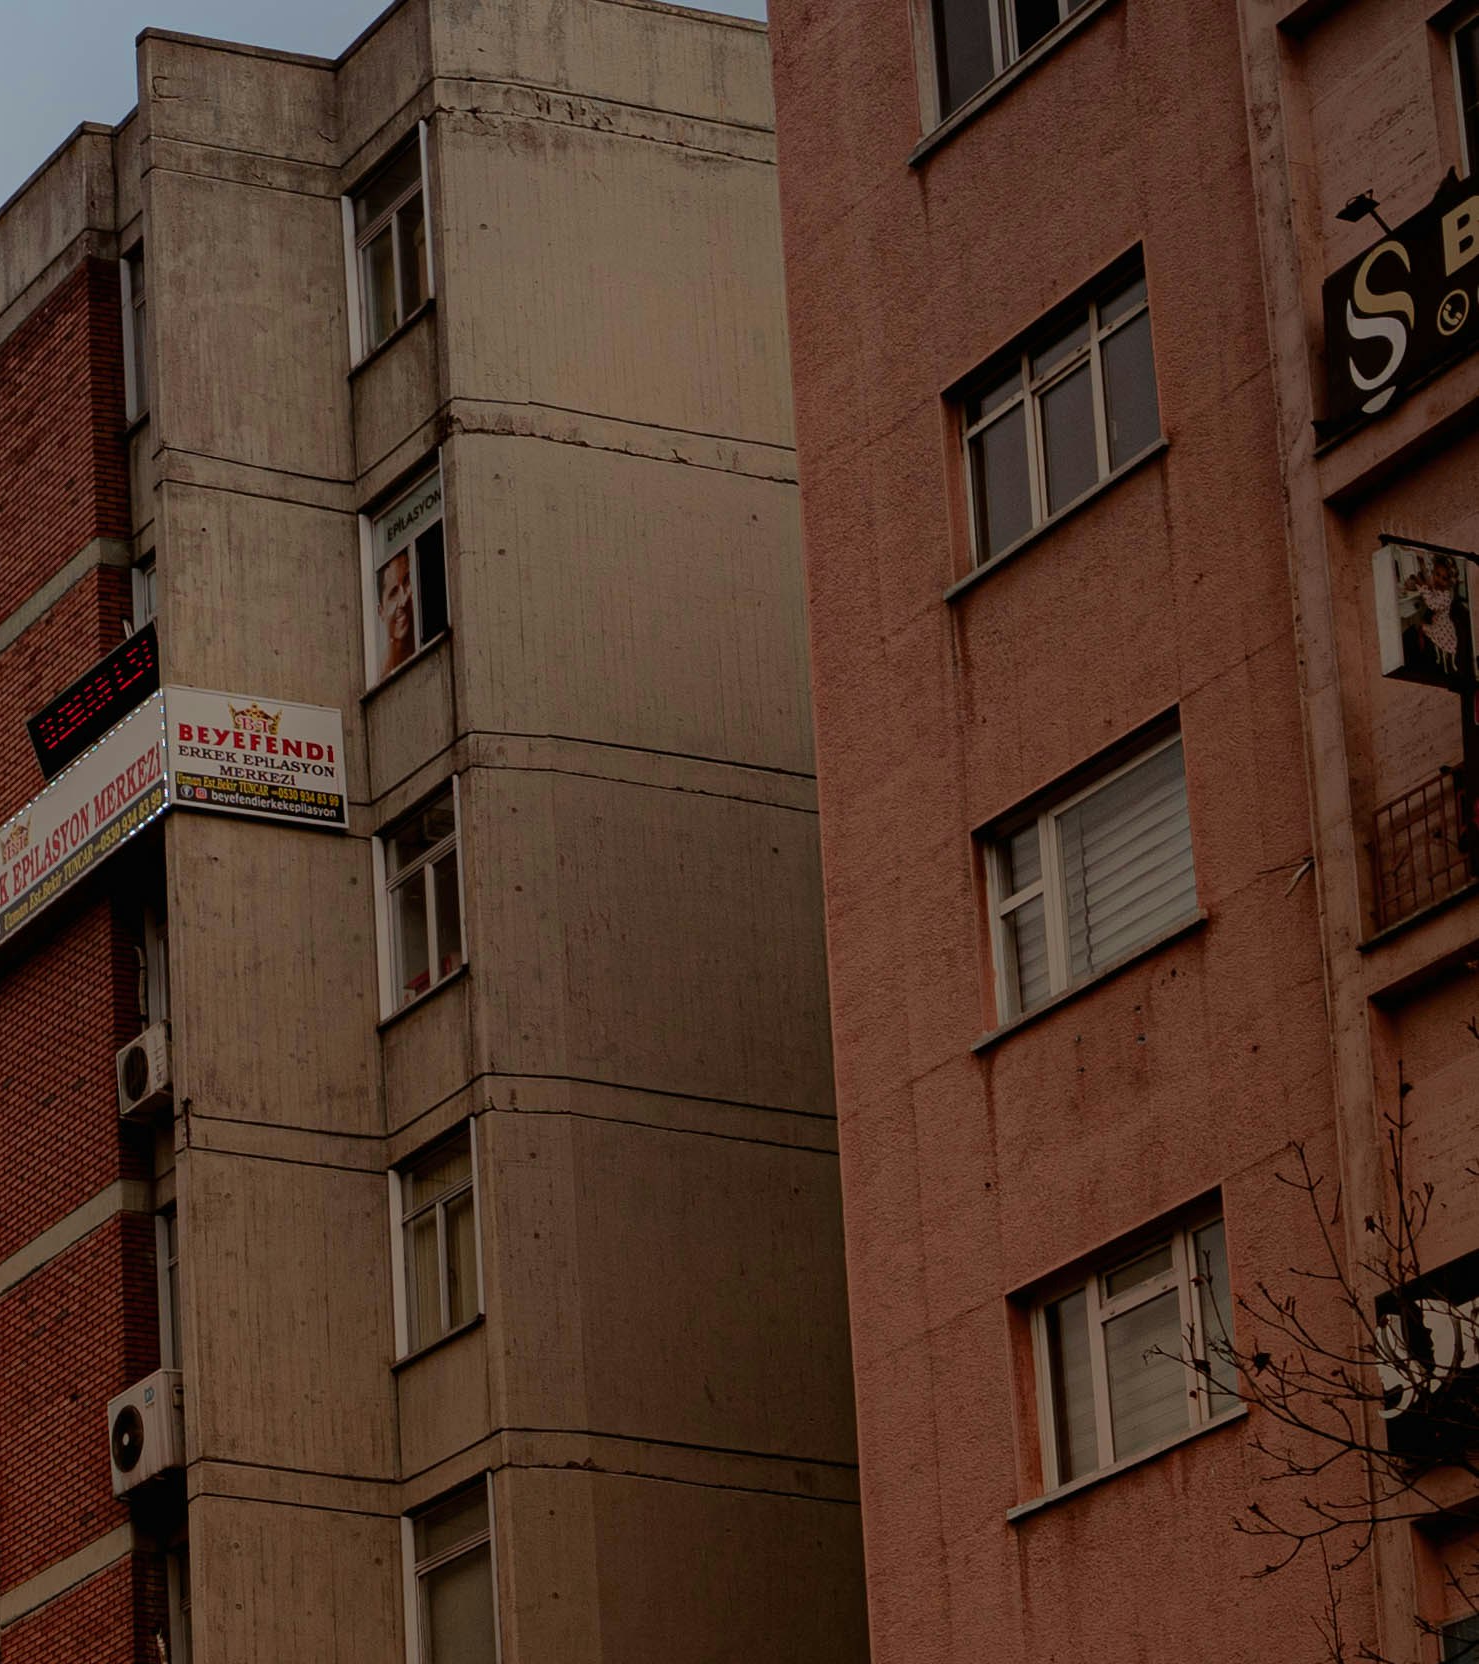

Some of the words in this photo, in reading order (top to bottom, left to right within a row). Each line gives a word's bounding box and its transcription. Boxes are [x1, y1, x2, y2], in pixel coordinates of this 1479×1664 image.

[177, 722, 335, 763] BEYEFENDİ
[177, 744, 237, 764] ERKEK
[242, 753, 336, 779] EPİLASYON
[219, 765, 296, 787] MERKEZİ
[12, 801, 90, 896] EPİLASYON
[94, 740, 162, 827] MERKEZİ
